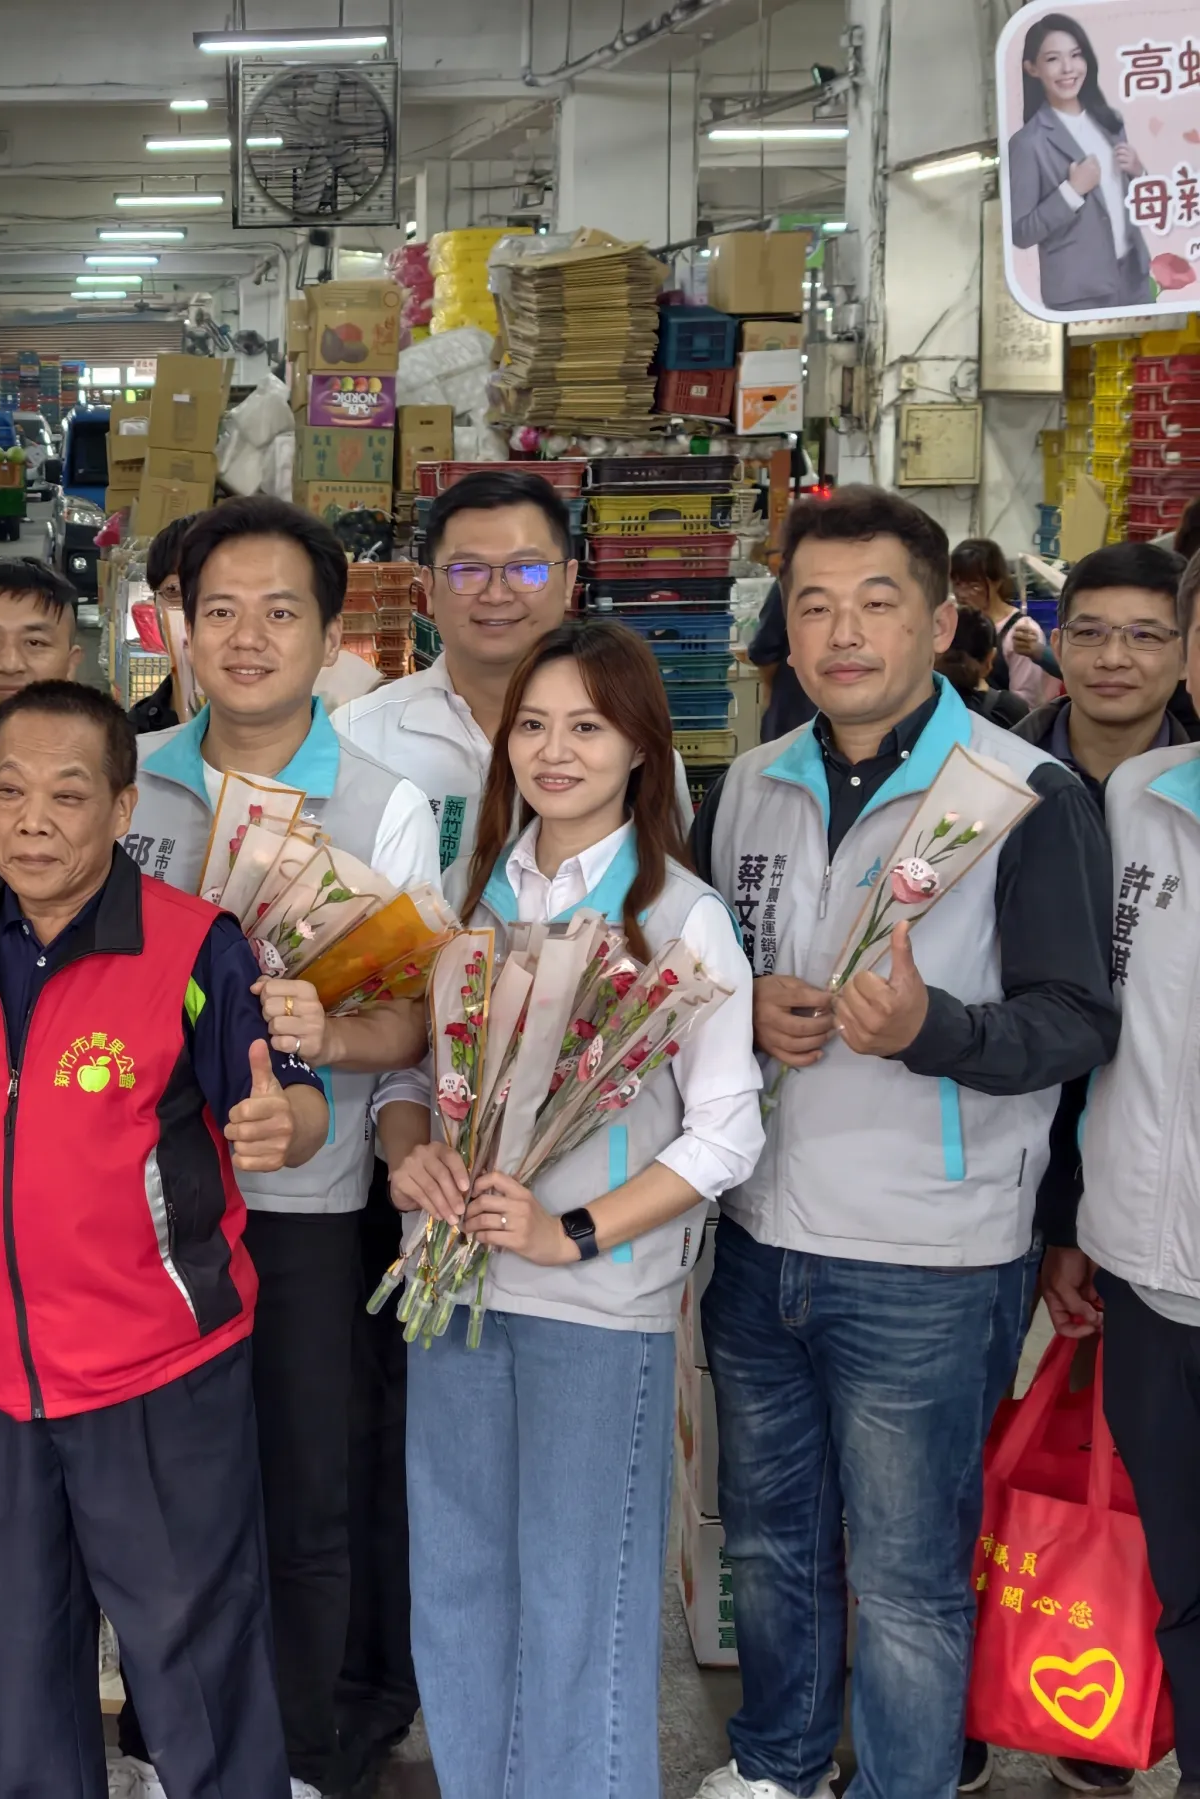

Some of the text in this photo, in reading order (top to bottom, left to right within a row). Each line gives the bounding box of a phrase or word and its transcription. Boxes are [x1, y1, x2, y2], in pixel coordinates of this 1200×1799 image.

[332, 392, 378, 404] NORDIC
[53, 1031, 137, 1090] 新竹市青果公會
[1000, 1586, 1094, 1629] 關心您
